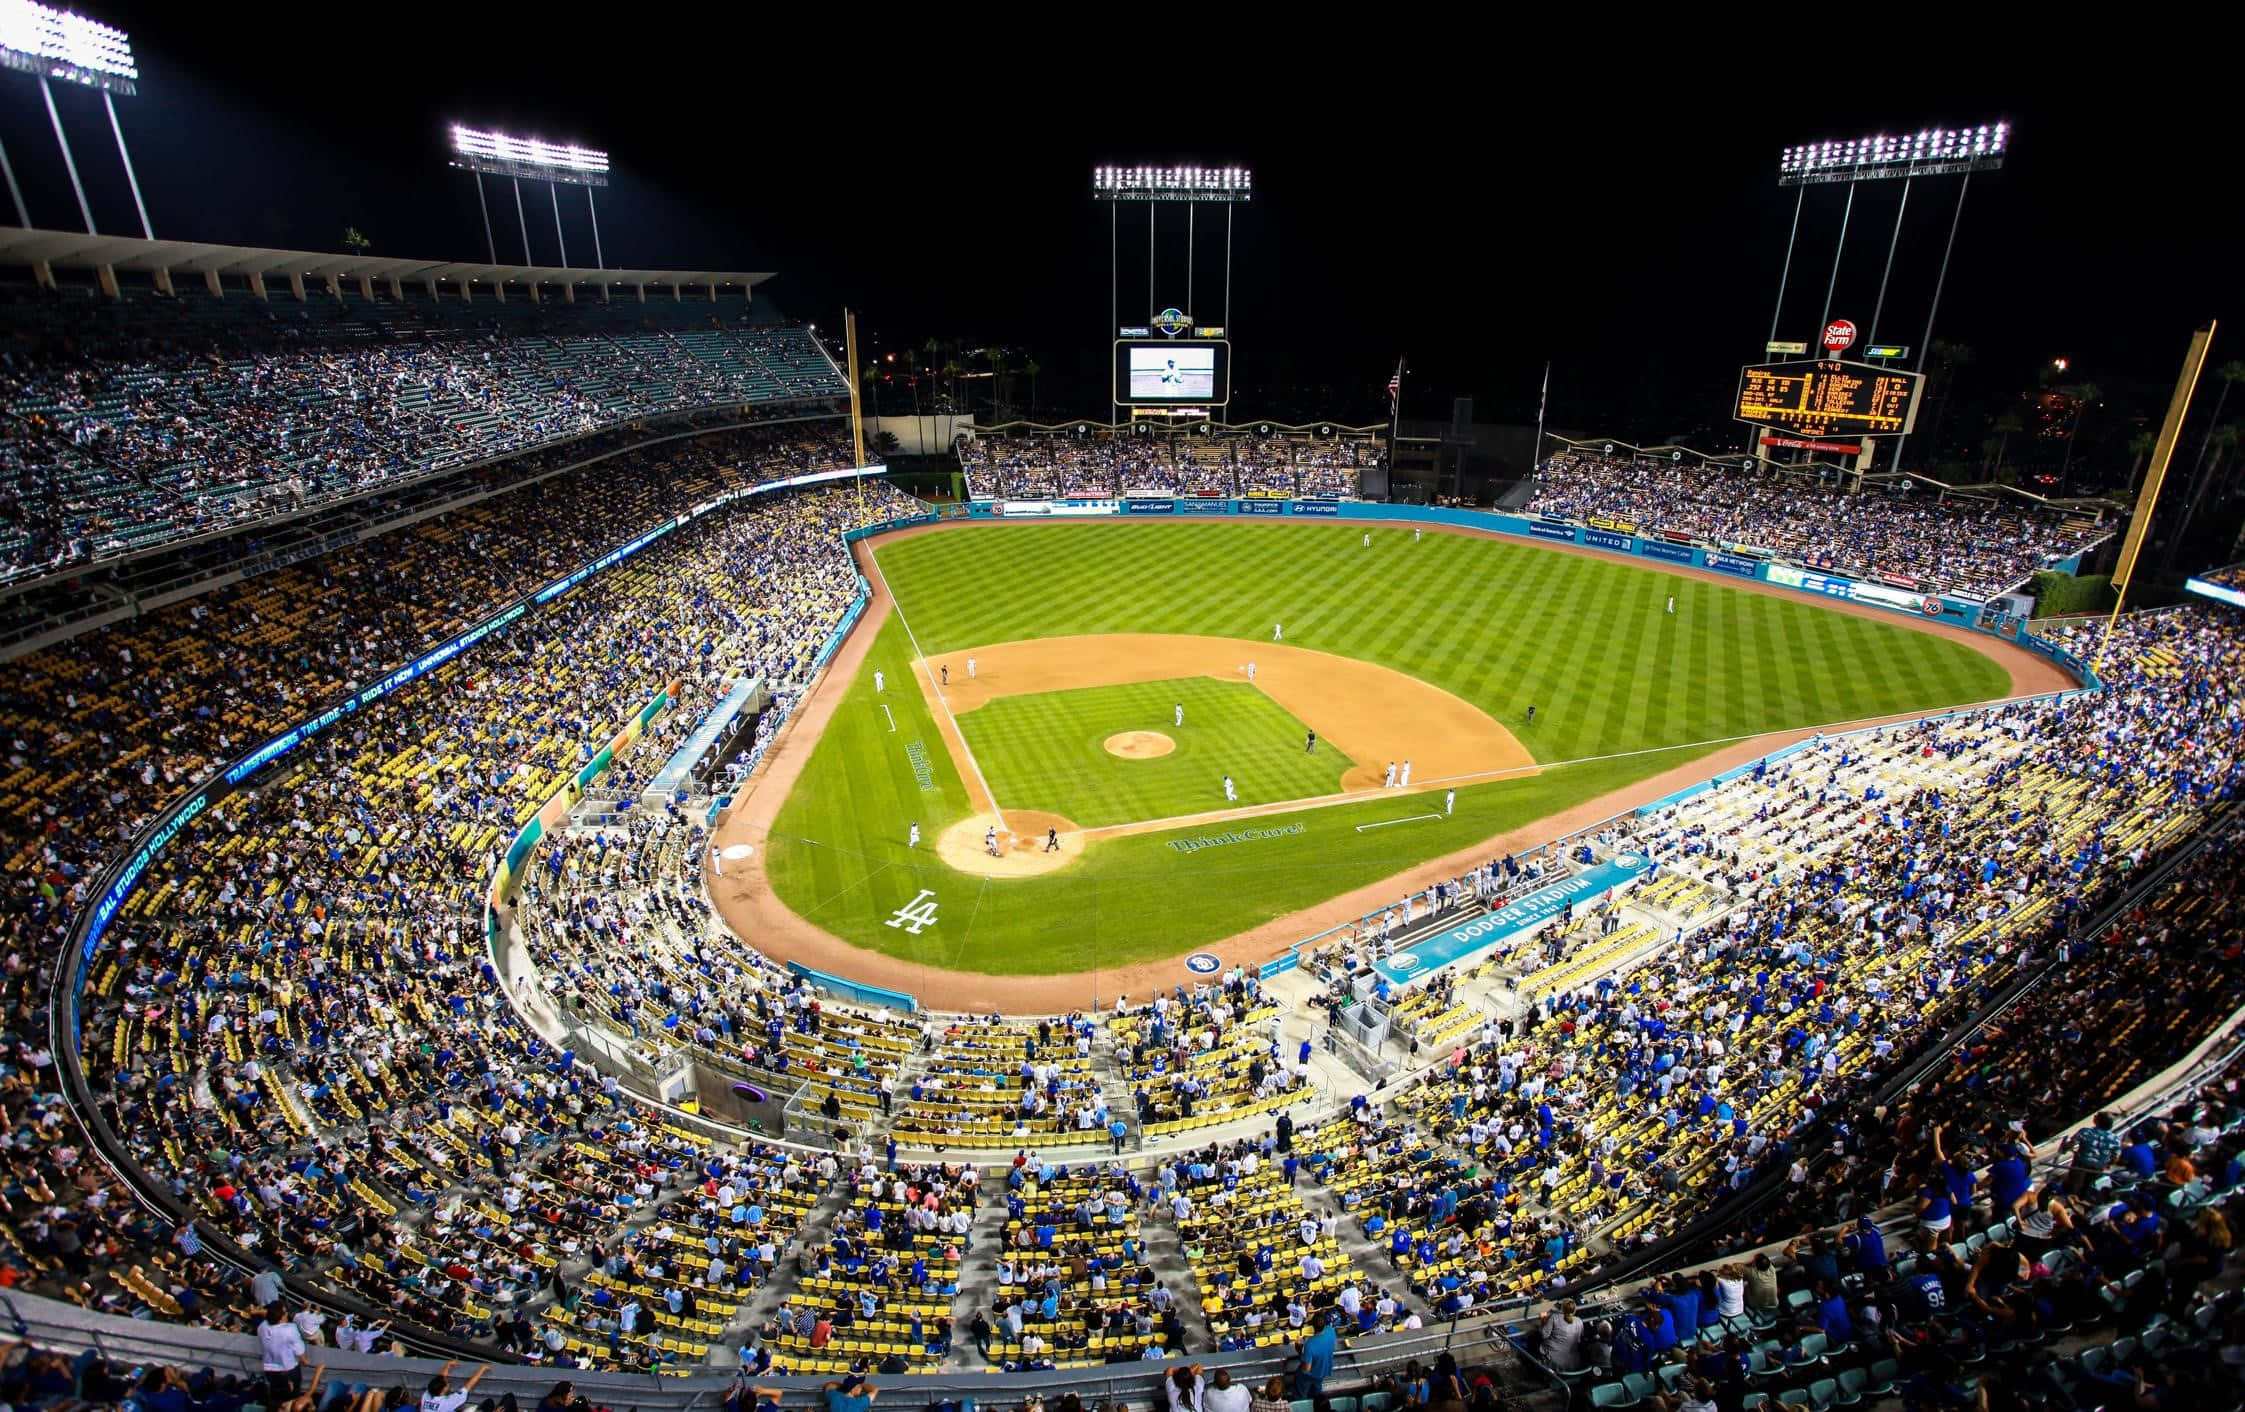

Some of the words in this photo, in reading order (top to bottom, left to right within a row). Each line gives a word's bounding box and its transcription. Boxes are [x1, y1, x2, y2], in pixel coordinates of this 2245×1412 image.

[1827, 325, 1852, 336] State
[1824, 334, 1849, 345] Farm
[1817, 362, 1841, 371] 9:40
[1585, 534, 1621, 547] UNITED
[1926, 603, 1938, 612] 76
[361, 686, 383, 704] RIDE
[394, 666, 414, 685] NOW
[300, 720, 320, 737] THE
[114, 848, 150, 899] STUDIOS
[149, 794, 207, 855] HOLLYWOOD
[884, 889, 938, 935] LA
[1453, 907, 1527, 942] DODGER
[1523, 878, 1592, 911] STADIUM
